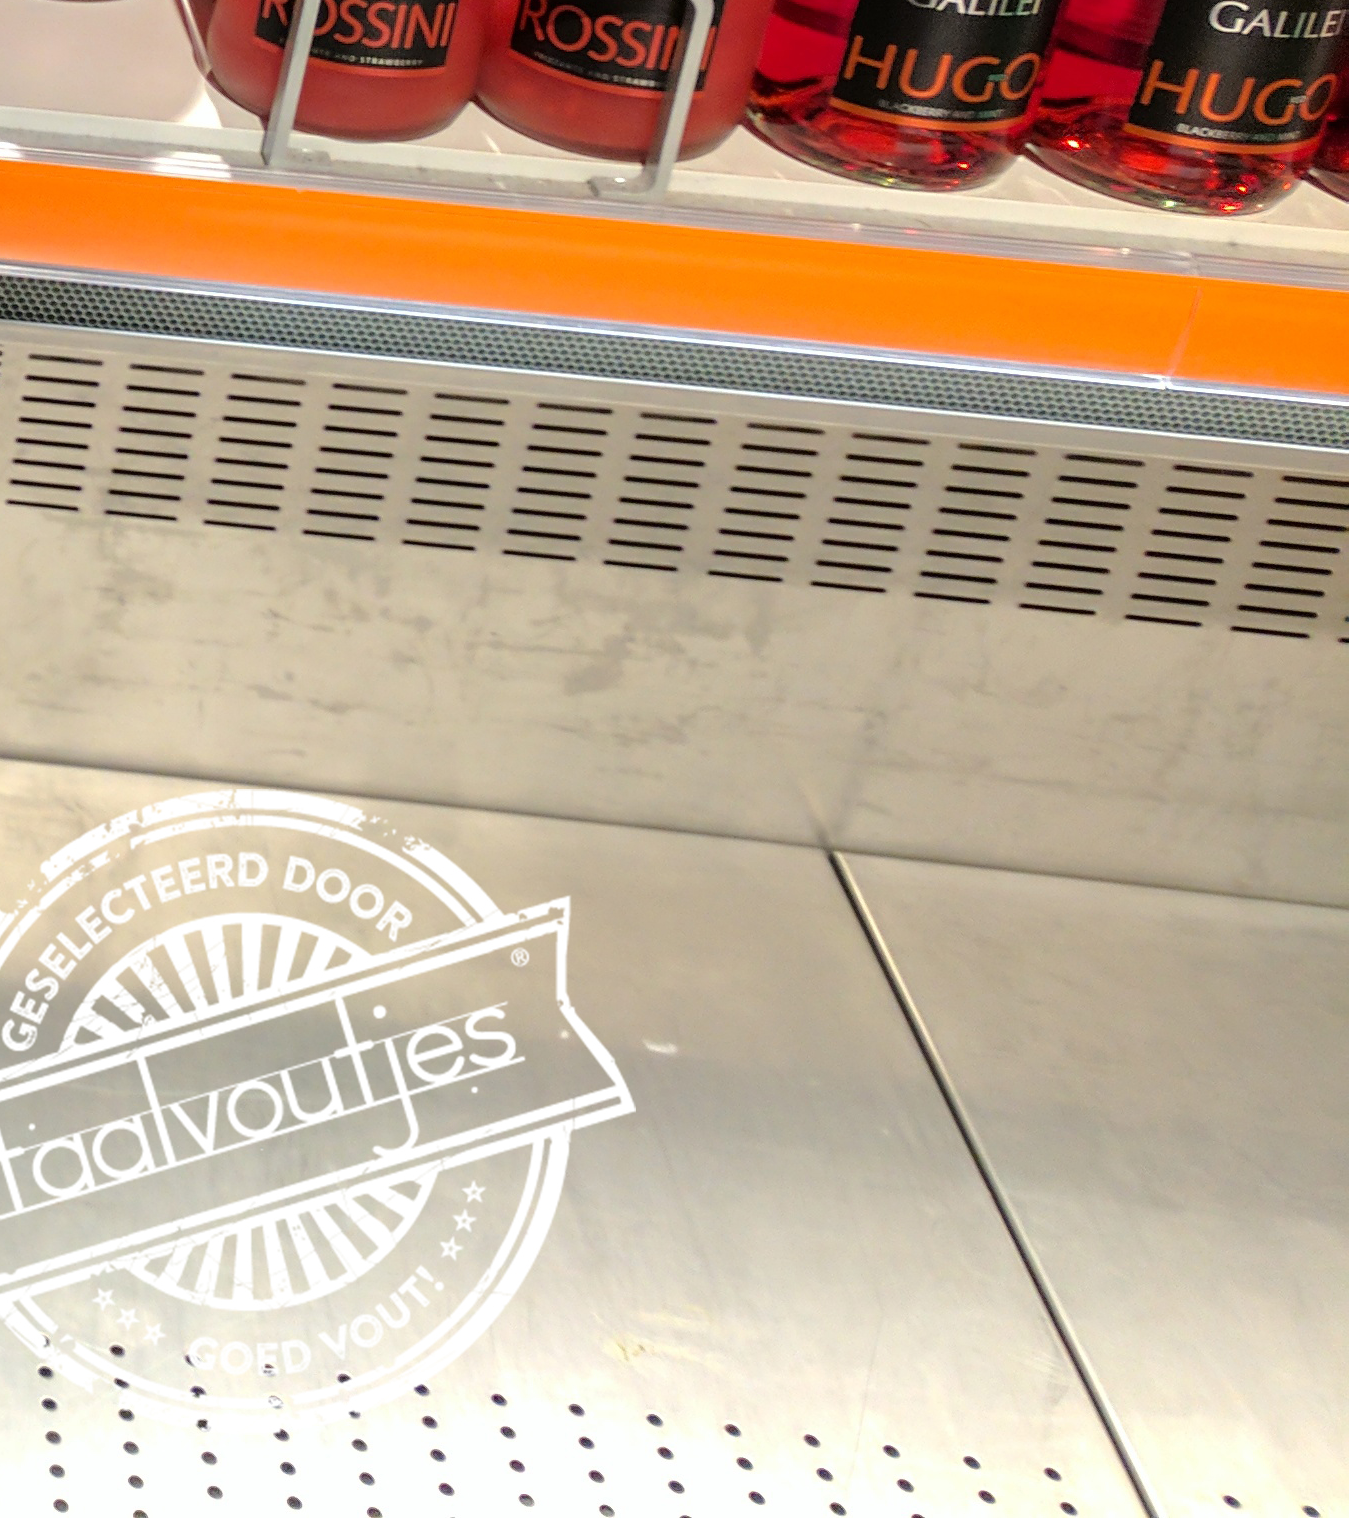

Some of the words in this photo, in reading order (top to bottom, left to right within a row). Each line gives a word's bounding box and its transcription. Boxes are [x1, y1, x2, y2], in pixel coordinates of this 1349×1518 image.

[1208, 0, 1347, 39] GALILEI
[843, 35, 1043, 104] HUGO
[1140, 60, 1337, 127] HUGO
